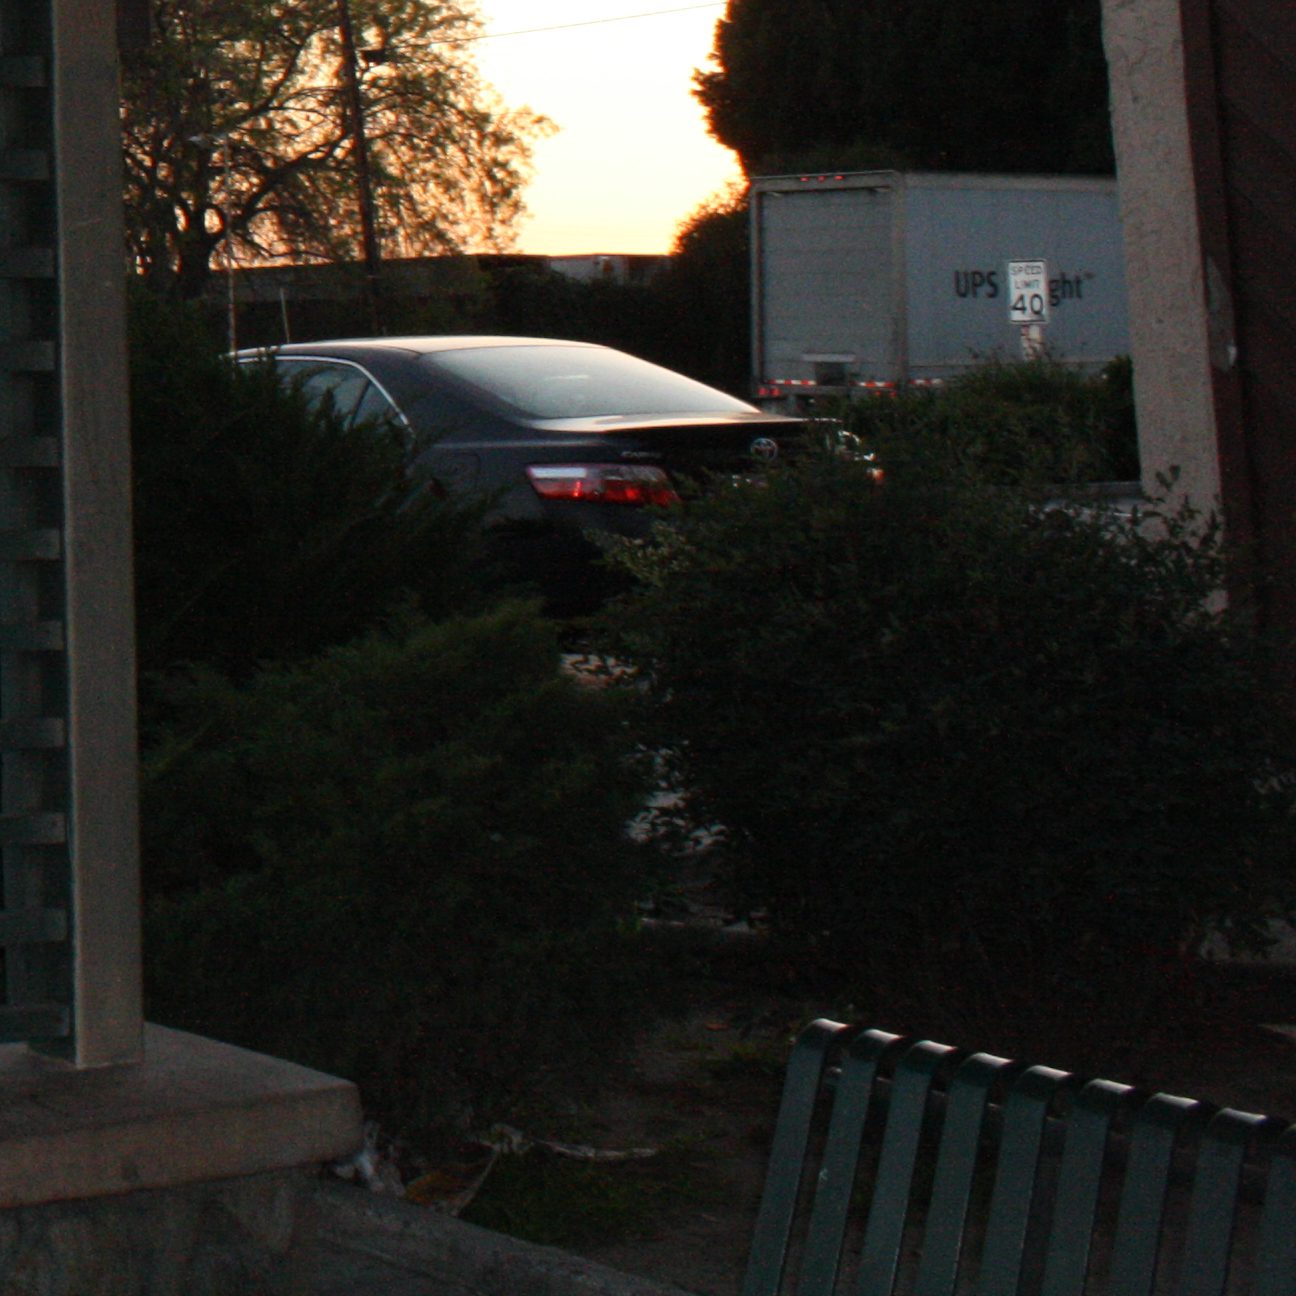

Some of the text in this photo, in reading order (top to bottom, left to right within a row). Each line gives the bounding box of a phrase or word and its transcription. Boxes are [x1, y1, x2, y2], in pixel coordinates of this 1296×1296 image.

[1010, 264, 1043, 275] SPEED
[954, 270, 1000, 299] UPS
[1014, 279, 1041, 290] LIMIT
[1010, 293, 1045, 316] 40
